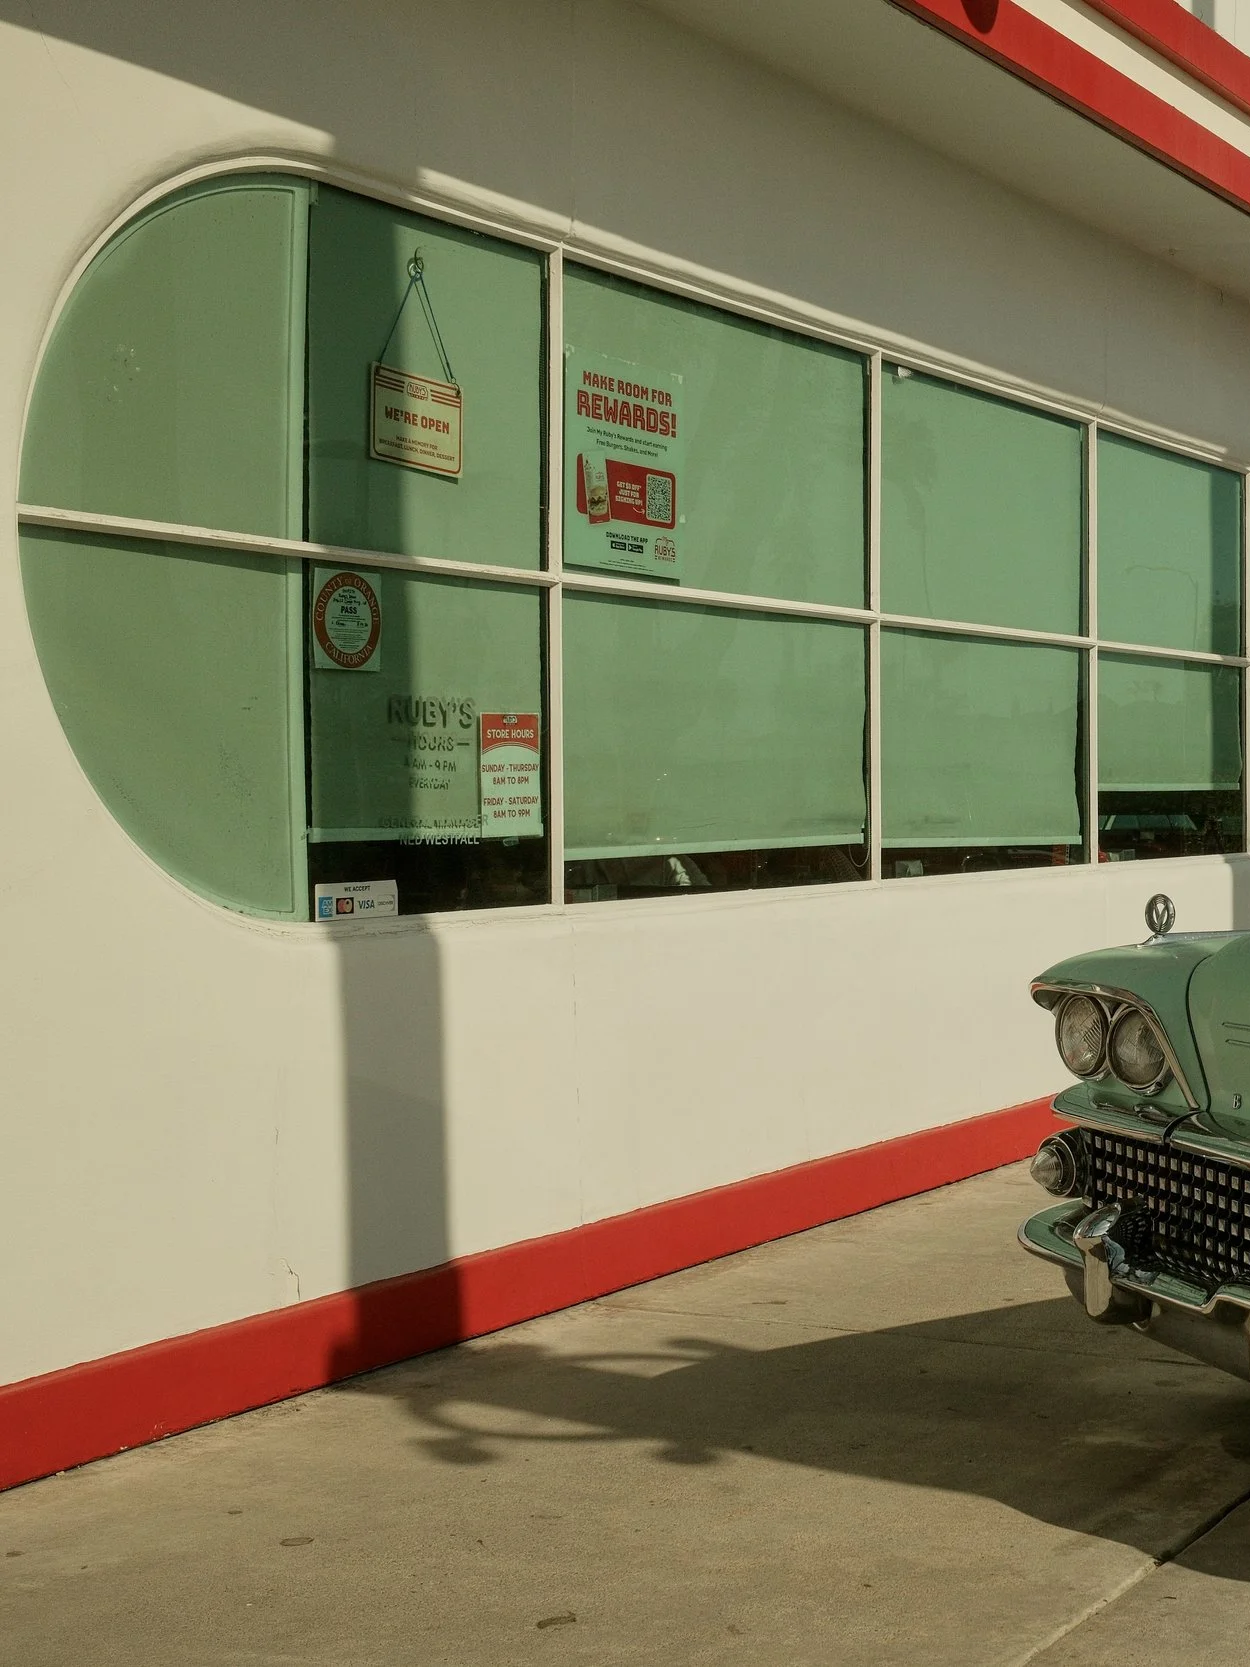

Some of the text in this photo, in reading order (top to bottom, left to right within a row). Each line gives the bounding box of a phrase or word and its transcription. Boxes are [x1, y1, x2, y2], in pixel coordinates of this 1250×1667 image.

[583, 370, 672, 407] MAKE ROOM FOR
[384, 405, 450, 435] WE'RE OPEN
[577, 389, 676, 438] REWARDS!
[396, 435, 407, 443] MAKE
[412, 439, 429, 449] MEMORY
[587, 426, 596, 434] Join
[597, 429, 603, 437] My
[603, 430, 617, 439] Ruby's
[617, 434, 634, 444] Rewards
[653, 442, 668, 452] earning
[596, 438, 606, 446] Free
[606, 440, 623, 450] Burgers,
[624, 445, 639, 454] Shakes,
[404, 445, 419, 454] LUNCH,
[420, 448, 436, 458] DINNER,
[437, 452, 455, 462] DESSERT
[616, 481, 625, 489] GET
[615, 495, 635, 505] SIGNING
[618, 489, 639, 499] JUST FOR
[606, 531, 630, 541] DOWNLOAD
[630, 535, 639, 543] THE
[654, 544, 676, 558] RUBY'S
[316, 575, 343, 622] COUNTY
[353, 577, 380, 625] ORANGE
[340, 605, 358, 615] PASS
[325, 640, 373, 665] CALIFORNIA
[387, 695, 476, 729] RUBY'S
[407, 731, 456, 751] HOURS
[486, 729, 534, 740] STORE HOURS
[434, 759, 441, 770] 9
[442, 760, 457, 772] PM
[481, 764, 505, 773] SUNDAY
[509, 763, 539, 773] THURSDAY
[408, 776, 451, 790] EVERYDAY
[493, 776, 530, 785] 8AM TO 8PM
[483, 797, 504, 807] FRIDAY
[508, 796, 539, 806] SATURDAY
[493, 809, 531, 819] 8AM TO 9PM
[400, 831, 480, 846] NED WESTFALL
[358, 899, 375, 909] VISA
